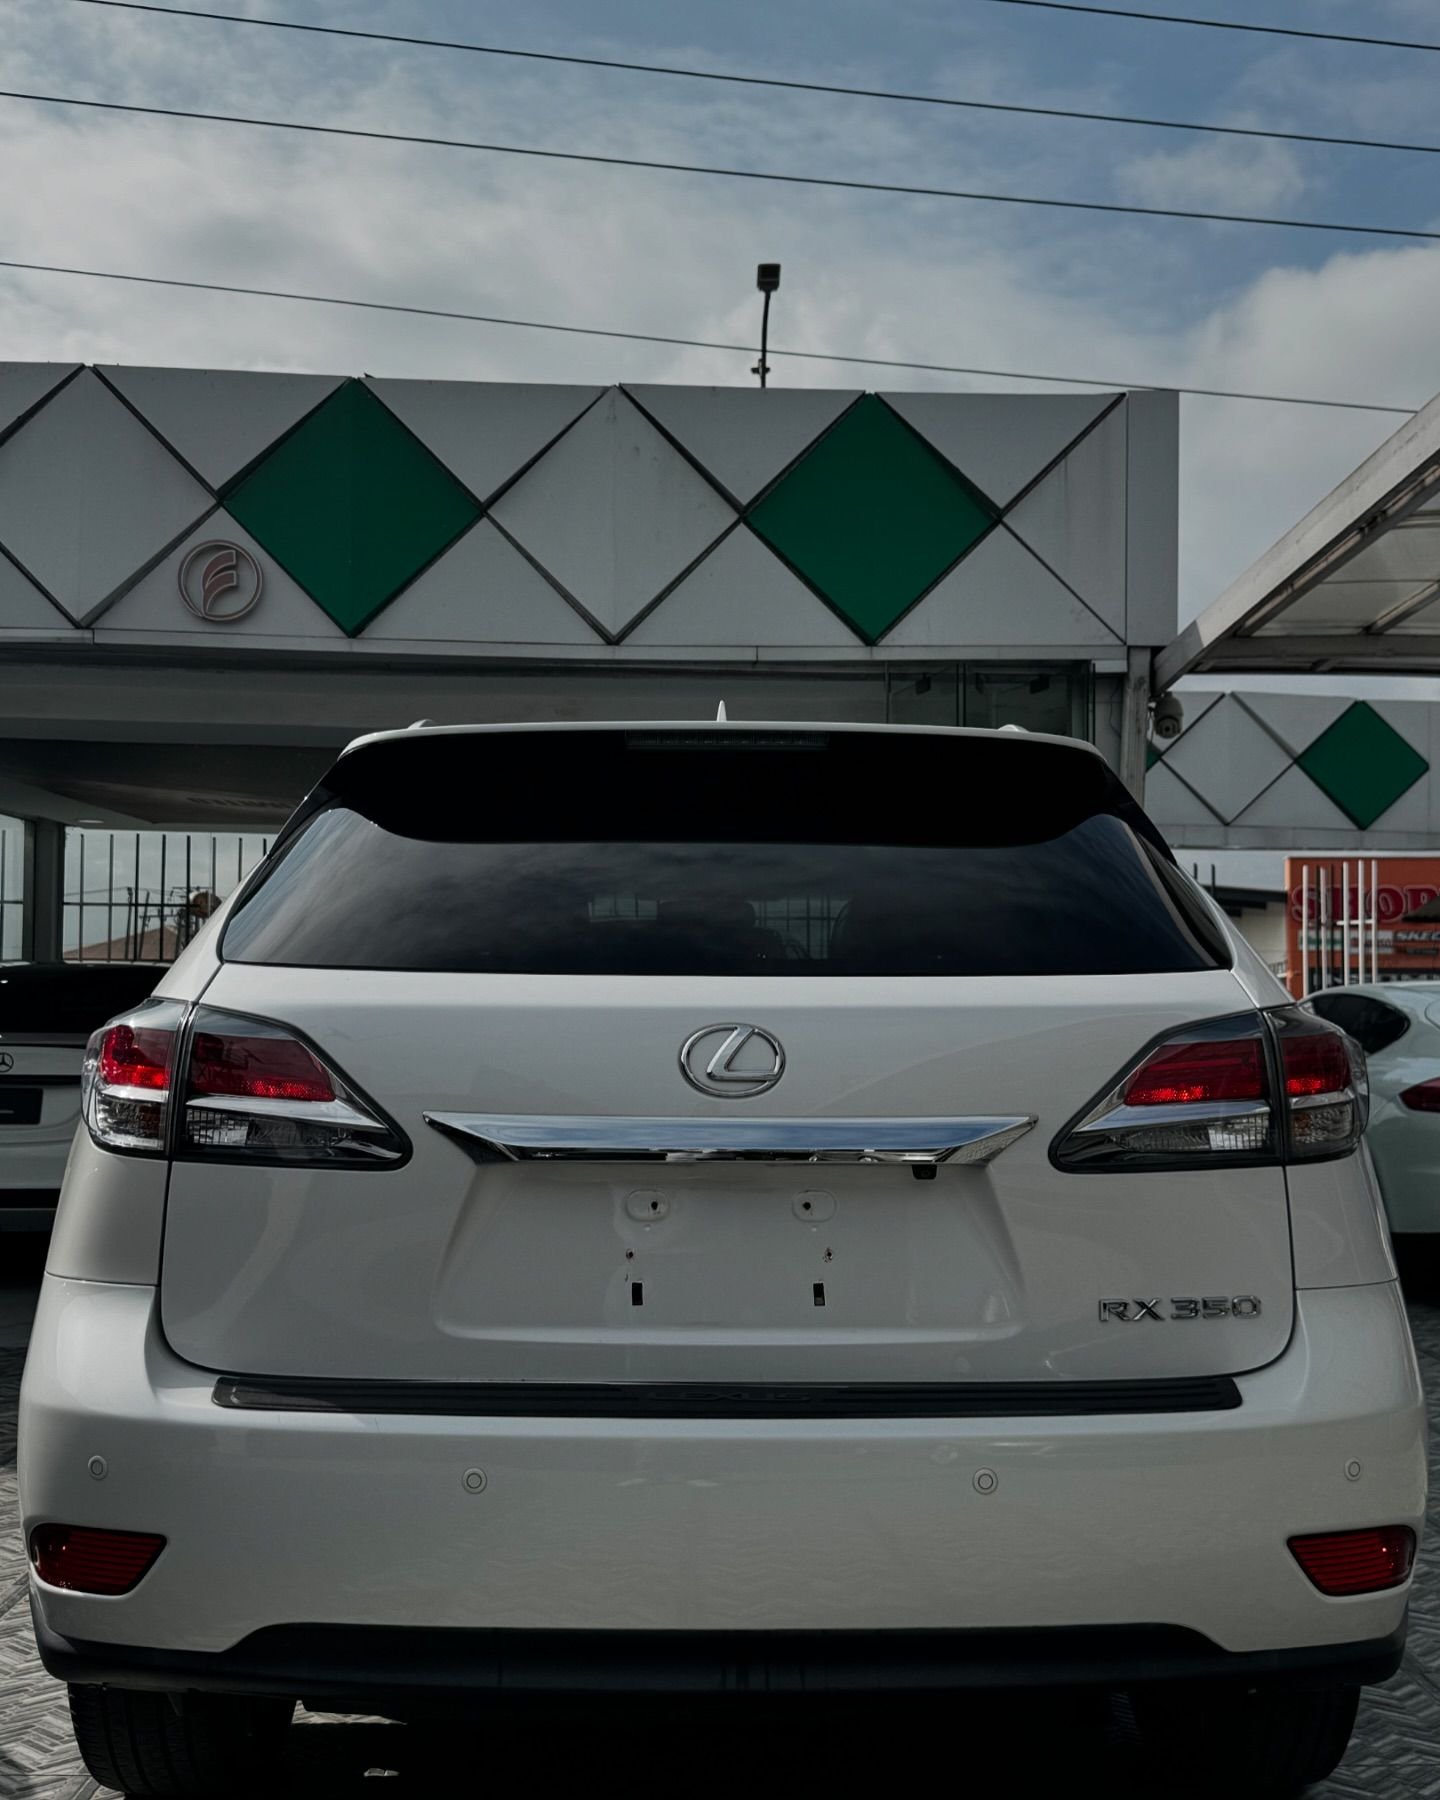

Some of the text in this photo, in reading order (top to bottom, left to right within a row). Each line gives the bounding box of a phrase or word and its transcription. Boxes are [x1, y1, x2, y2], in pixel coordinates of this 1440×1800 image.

[1098, 1294, 1262, 1322] RX 350
[647, 1390, 812, 1402] LEXUS
